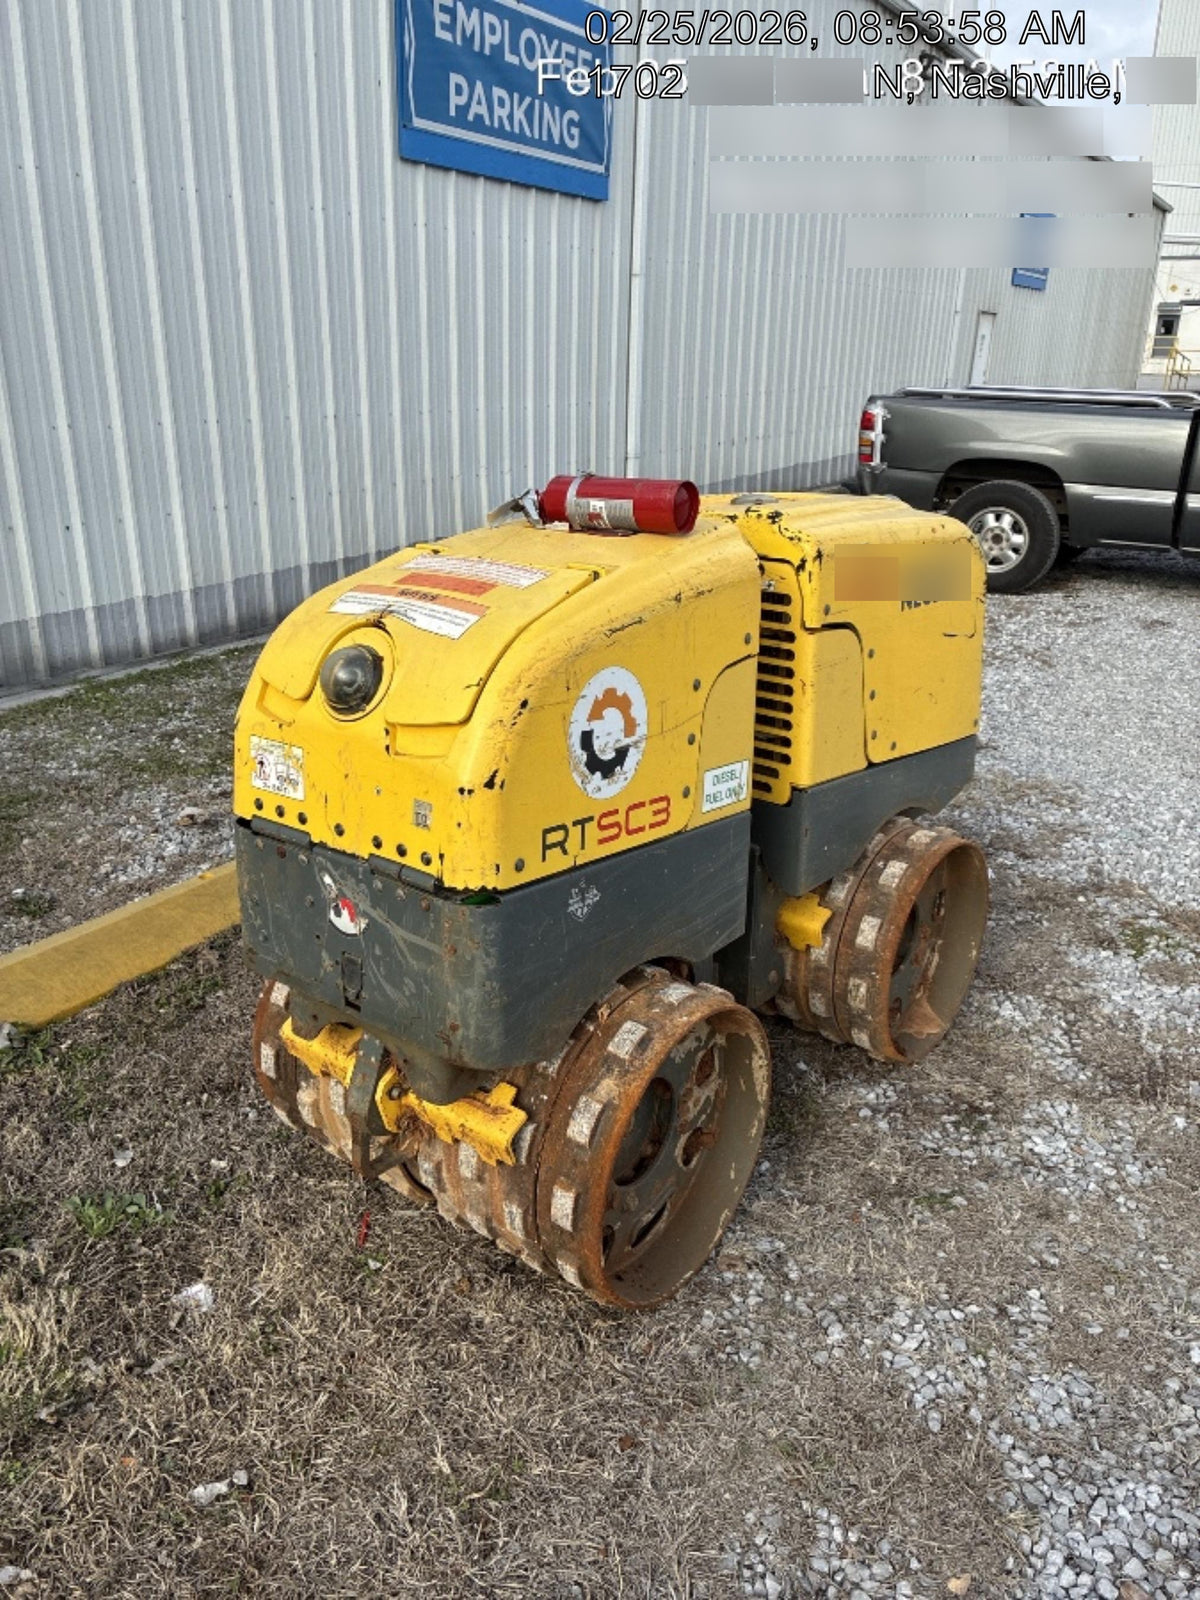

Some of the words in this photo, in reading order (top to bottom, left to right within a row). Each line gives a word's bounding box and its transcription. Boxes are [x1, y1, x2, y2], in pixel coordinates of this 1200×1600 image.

[433, 0, 593, 83] EMPLOYEE
[449, 72, 581, 149] PARKING
[705, 790, 725, 804] FUEL
[712, 769, 739, 786] DIESEL
[541, 795, 671, 862] RTSC3
